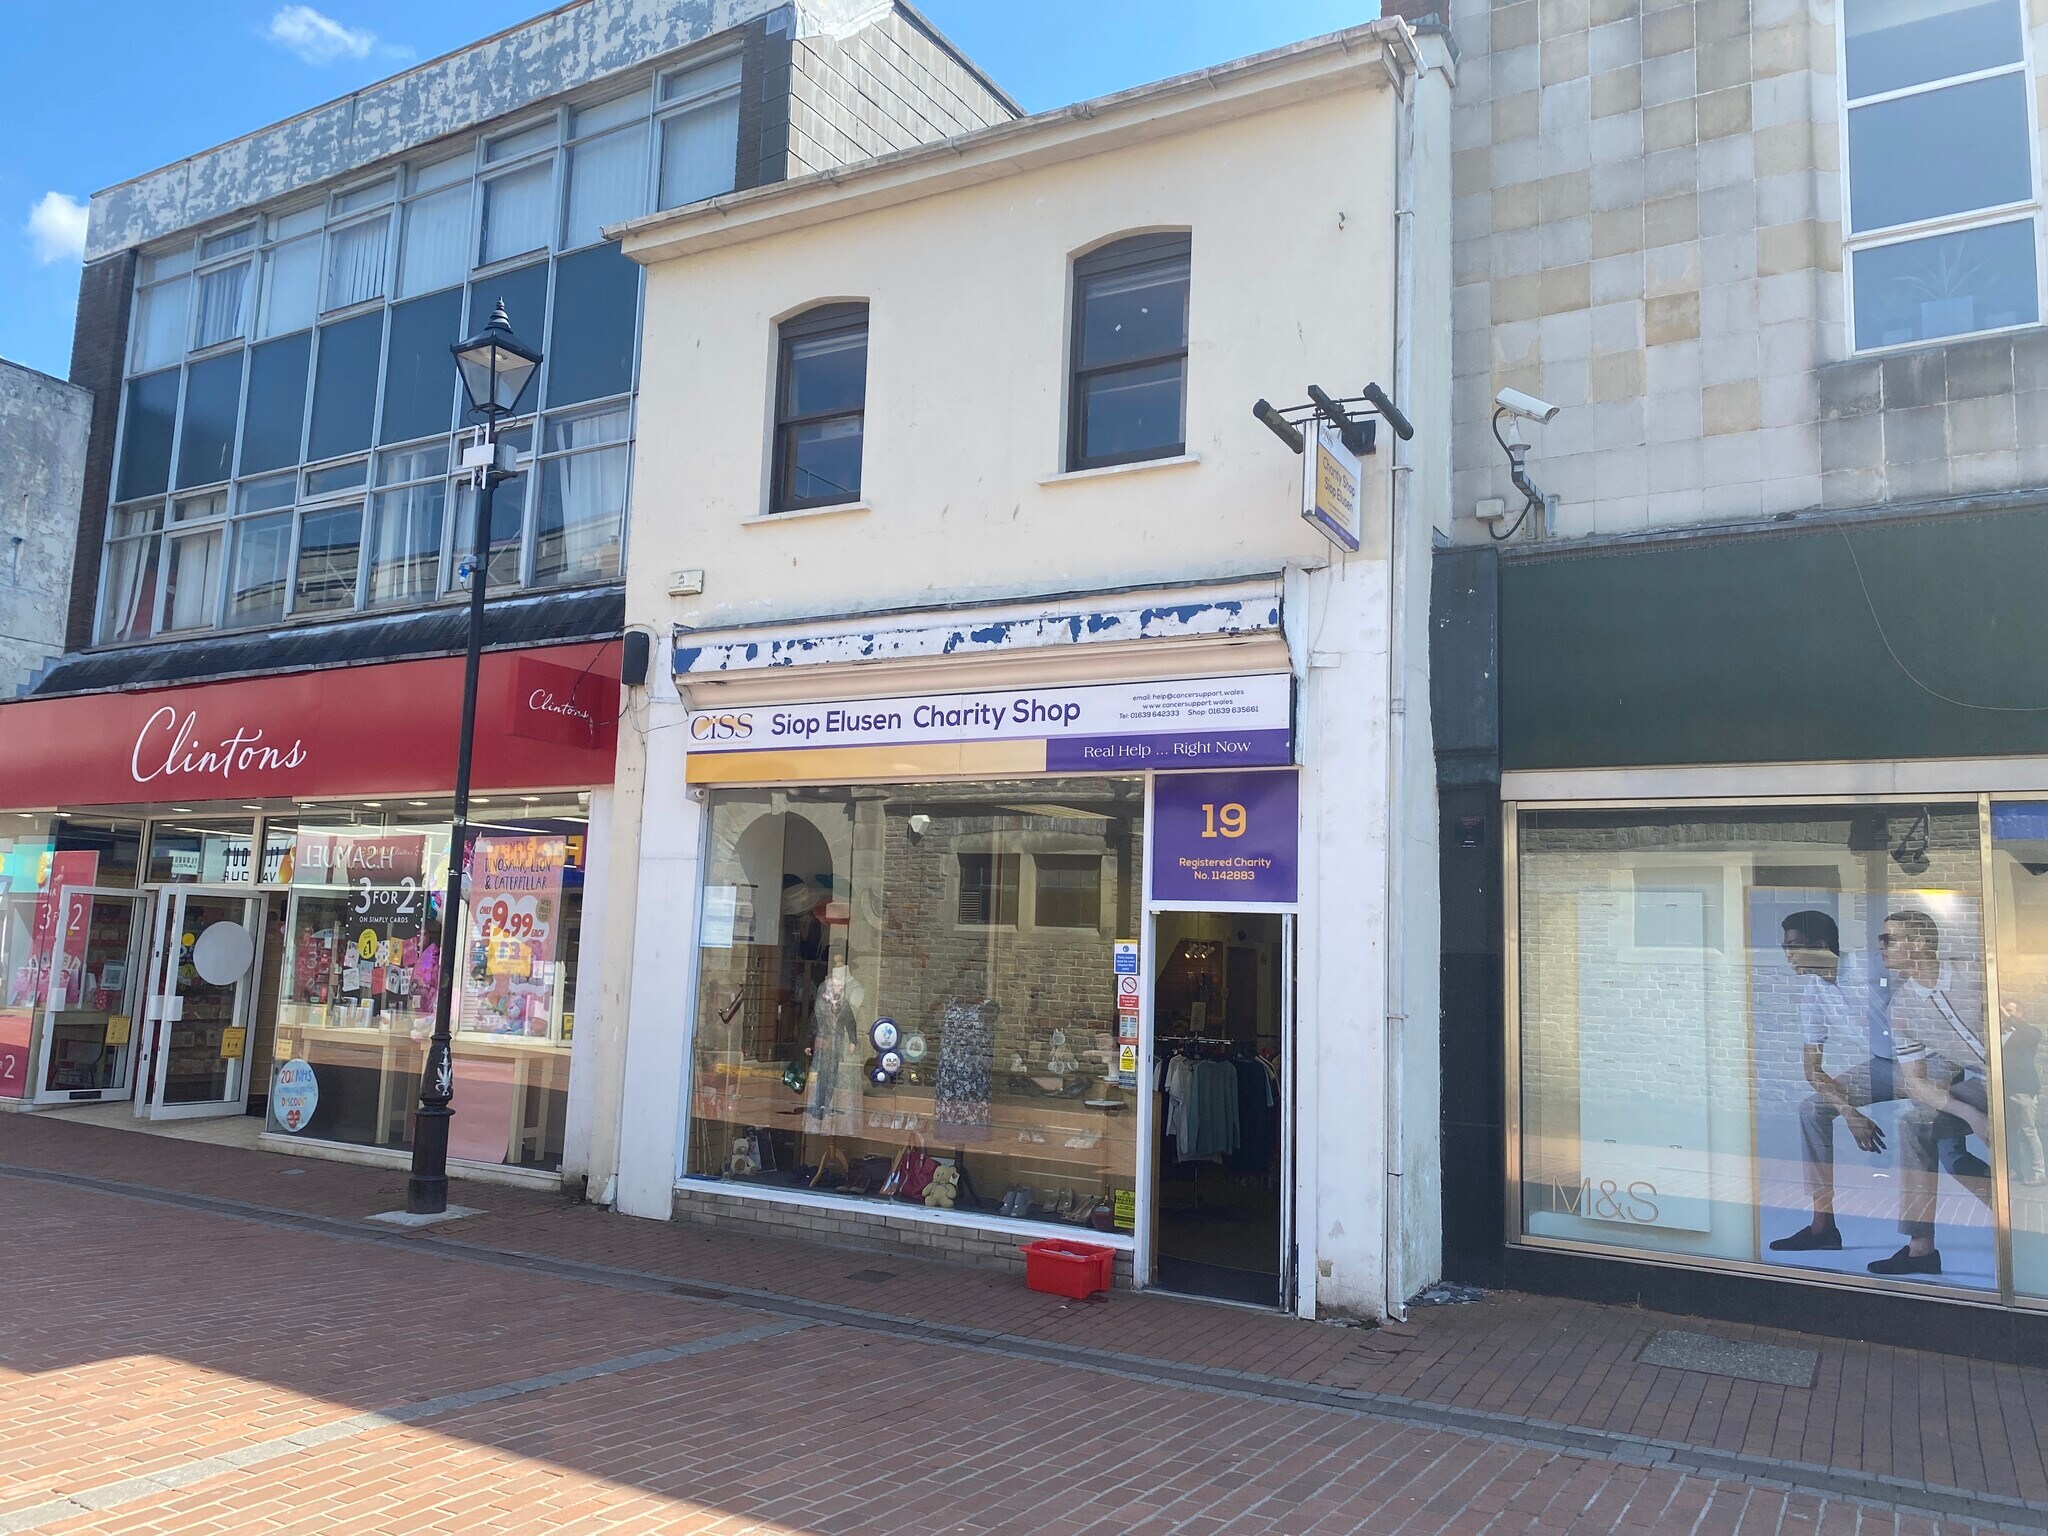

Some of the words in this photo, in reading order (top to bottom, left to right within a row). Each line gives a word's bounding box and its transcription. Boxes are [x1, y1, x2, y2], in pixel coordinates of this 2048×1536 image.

[1322, 456, 1342, 487] Charity
[1342, 475, 1356, 497] Shop
[1324, 476, 1337, 499] Siop
[1336, 489, 1354, 514] Elusen
[529, 688, 589, 718] Clintons
[1142, 698, 1234, 709] www.cancersupport.wales
[1152, 689, 1245, 701] help@cancersupport.wales
[771, 713, 820, 739] Siop
[826, 710, 902, 733] Elusen
[913, 702, 1006, 731] Charity
[1012, 698, 1081, 727] Shop
[1130, 711, 1152, 719] 01639
[1152, 709, 1180, 718] 642333
[1208, 707, 1231, 715] 01639
[1231, 706, 1259, 714] 635661
[131, 706, 307, 783] Clintons
[1084, 744, 1114, 758] Real
[1118, 743, 1151, 759] Help
[1173, 740, 1211, 757] Right
[1215, 740, 1252, 754] Now
[1202, 803, 1247, 838] 19
[530, 857, 552, 872] LION
[1179, 857, 1232, 870] Registered
[1233, 857, 1272, 869] Charity
[484, 875, 491, 890] &
[494, 875, 548, 891] CATERPILLAR
[1194, 870, 1210, 880] No.
[1211, 870, 1255, 880] 1142883
[355, 876, 372, 914] 3
[372, 890, 398, 905] FOR
[396, 876, 416, 914] 2
[69, 903, 83, 931] 2
[358, 916, 368, 924] ON
[369, 916, 388, 924] SIMPLY
[389, 916, 409, 924] CARDS
[530, 929, 545, 938] EACH
[295, 1068, 312, 1083] NHS
[1552, 1174, 1660, 1224] M&S
